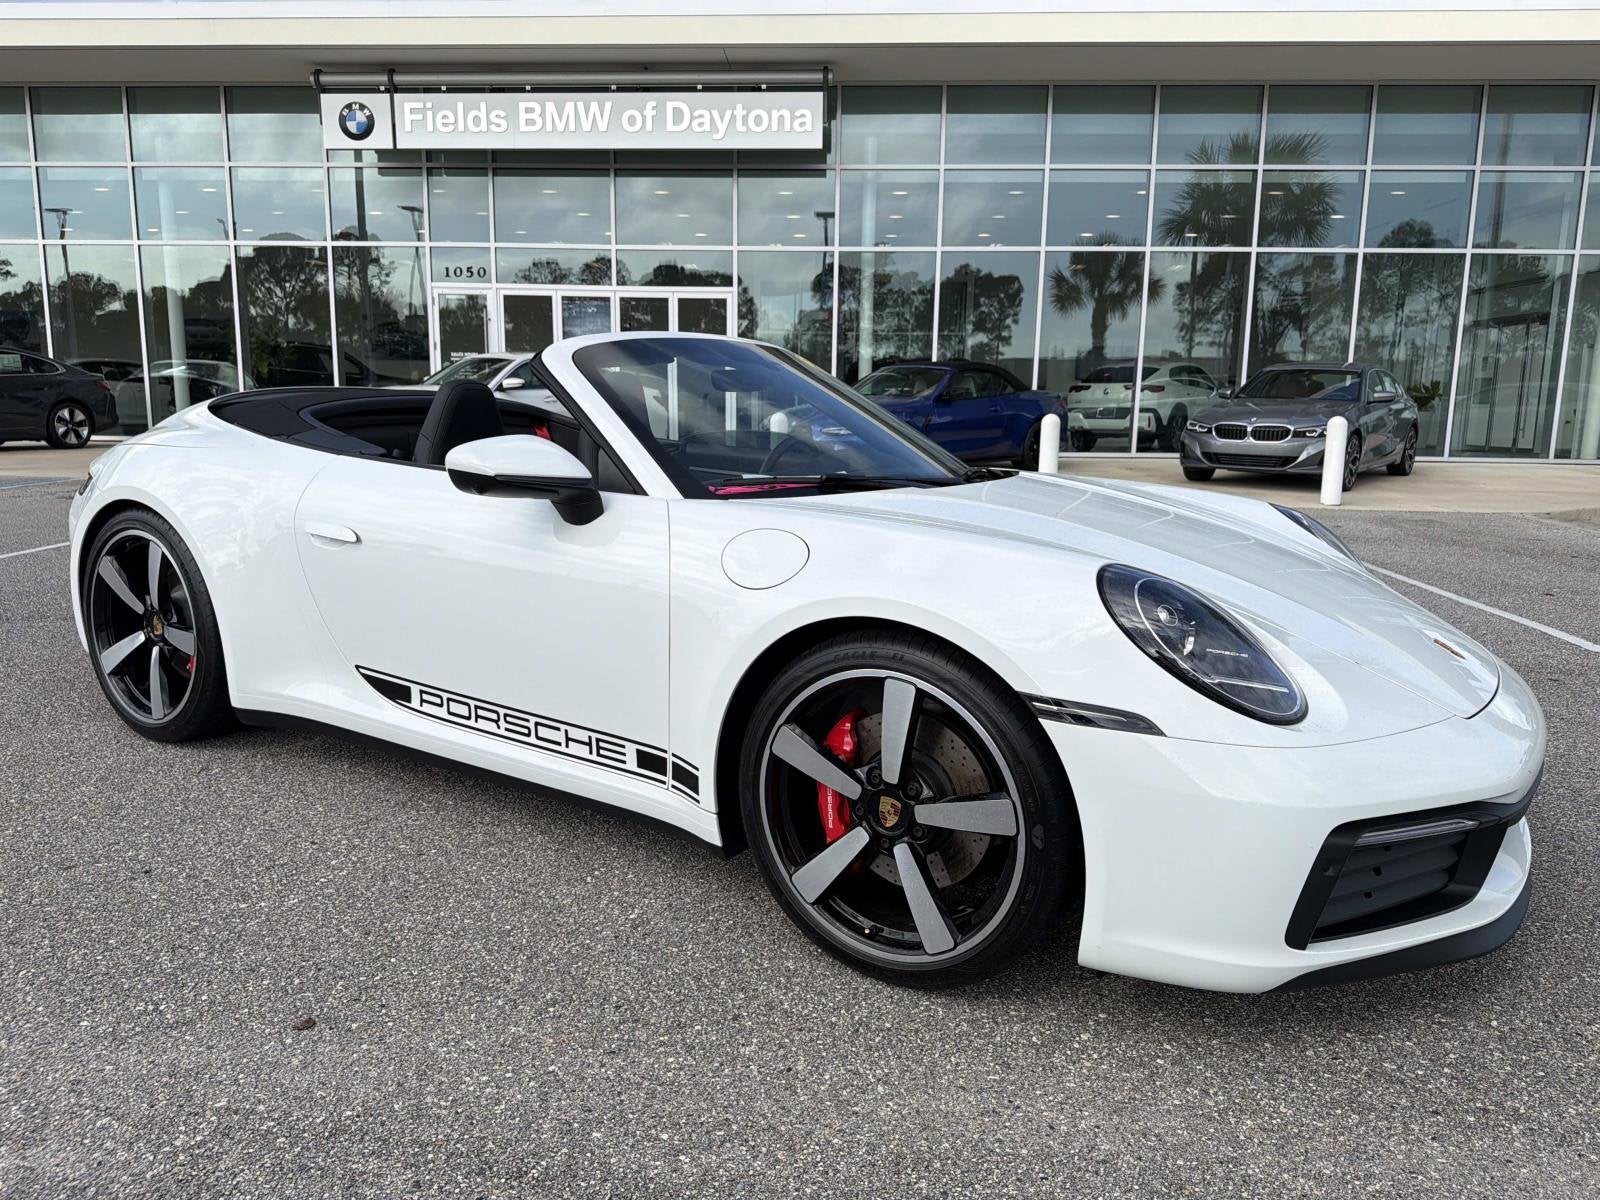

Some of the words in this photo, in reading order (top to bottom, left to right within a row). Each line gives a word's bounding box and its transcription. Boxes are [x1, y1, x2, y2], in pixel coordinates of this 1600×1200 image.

[341, 103, 371, 117] BMW
[403, 101, 509, 134] Fields
[518, 101, 613, 133] BMW
[621, 100, 658, 133] of
[665, 100, 814, 141] Daytona
[444, 265, 487, 278] 1050
[1205, 648, 1249, 658] PORSCHE
[419, 689, 627, 765] PORSCHE
